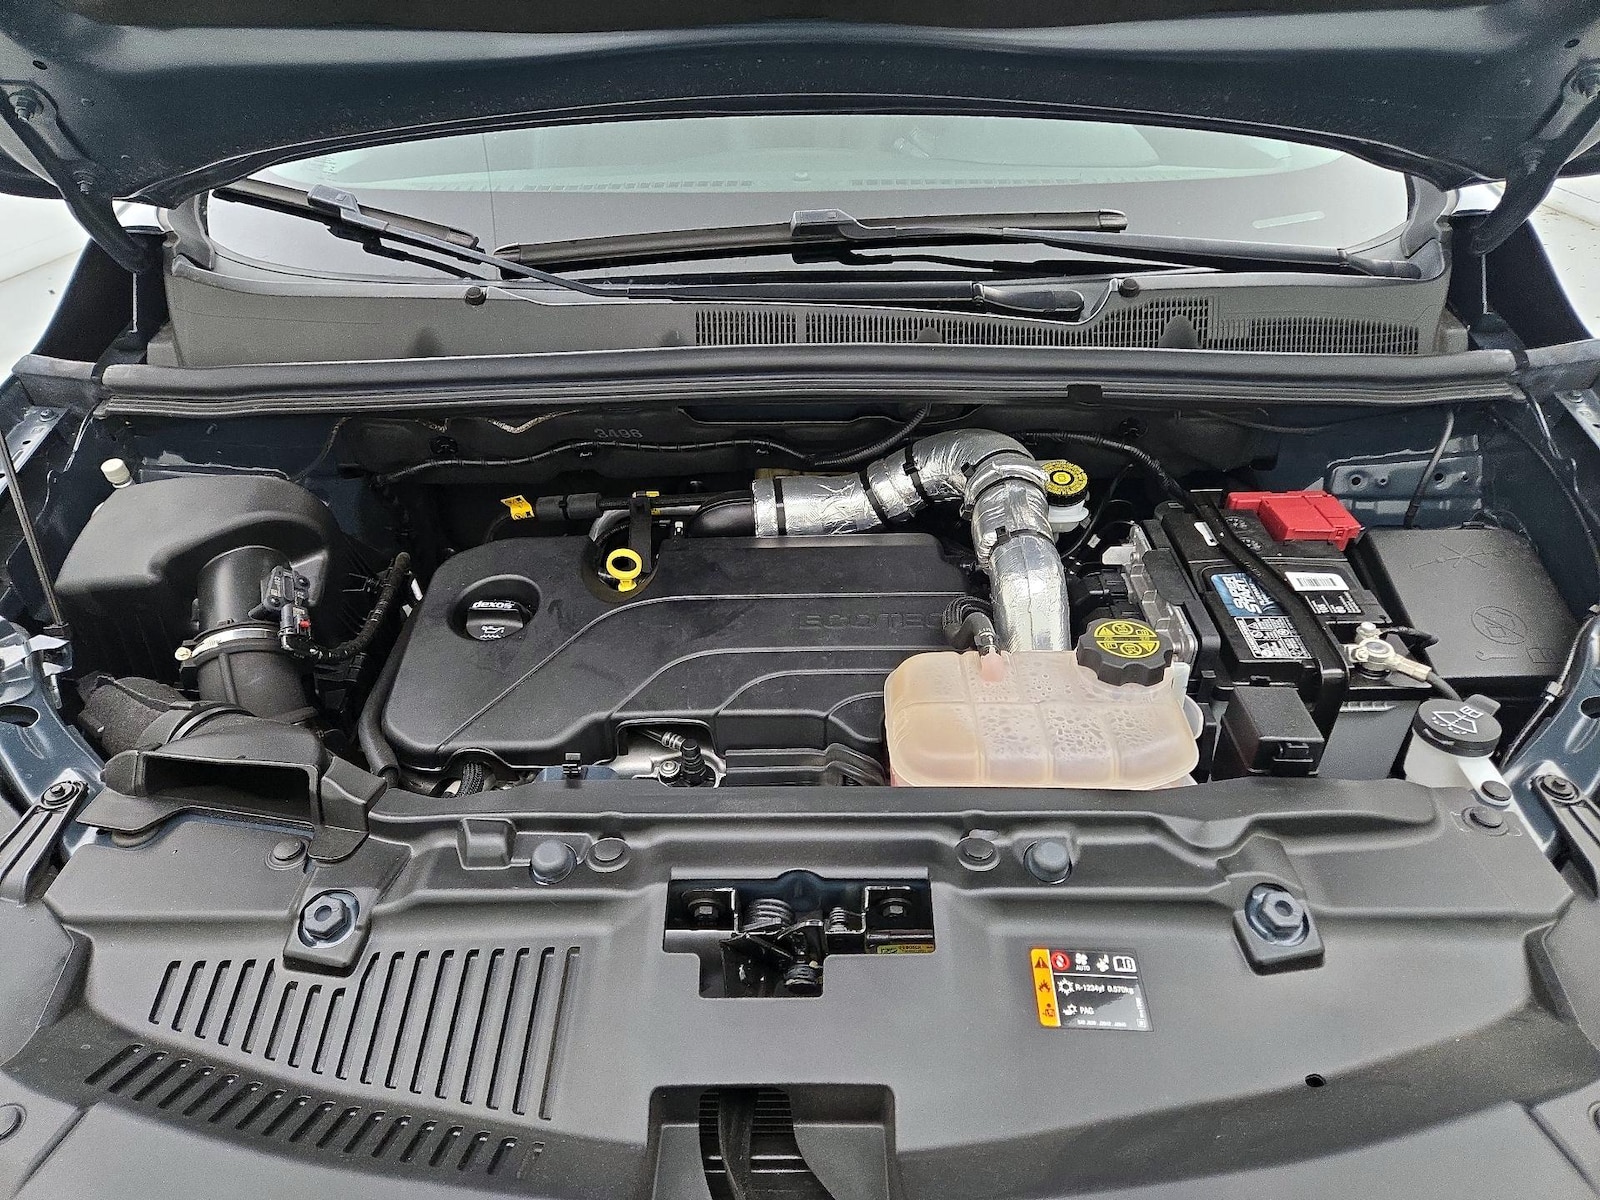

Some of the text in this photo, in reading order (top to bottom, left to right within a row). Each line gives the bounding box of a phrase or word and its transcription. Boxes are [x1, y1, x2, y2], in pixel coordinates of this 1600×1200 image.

[1222, 576, 1244, 609] SUPER
[1235, 578, 1262, 614] START
[472, 600, 515, 609] dexos
[1079, 1006, 1095, 1015] PAG
